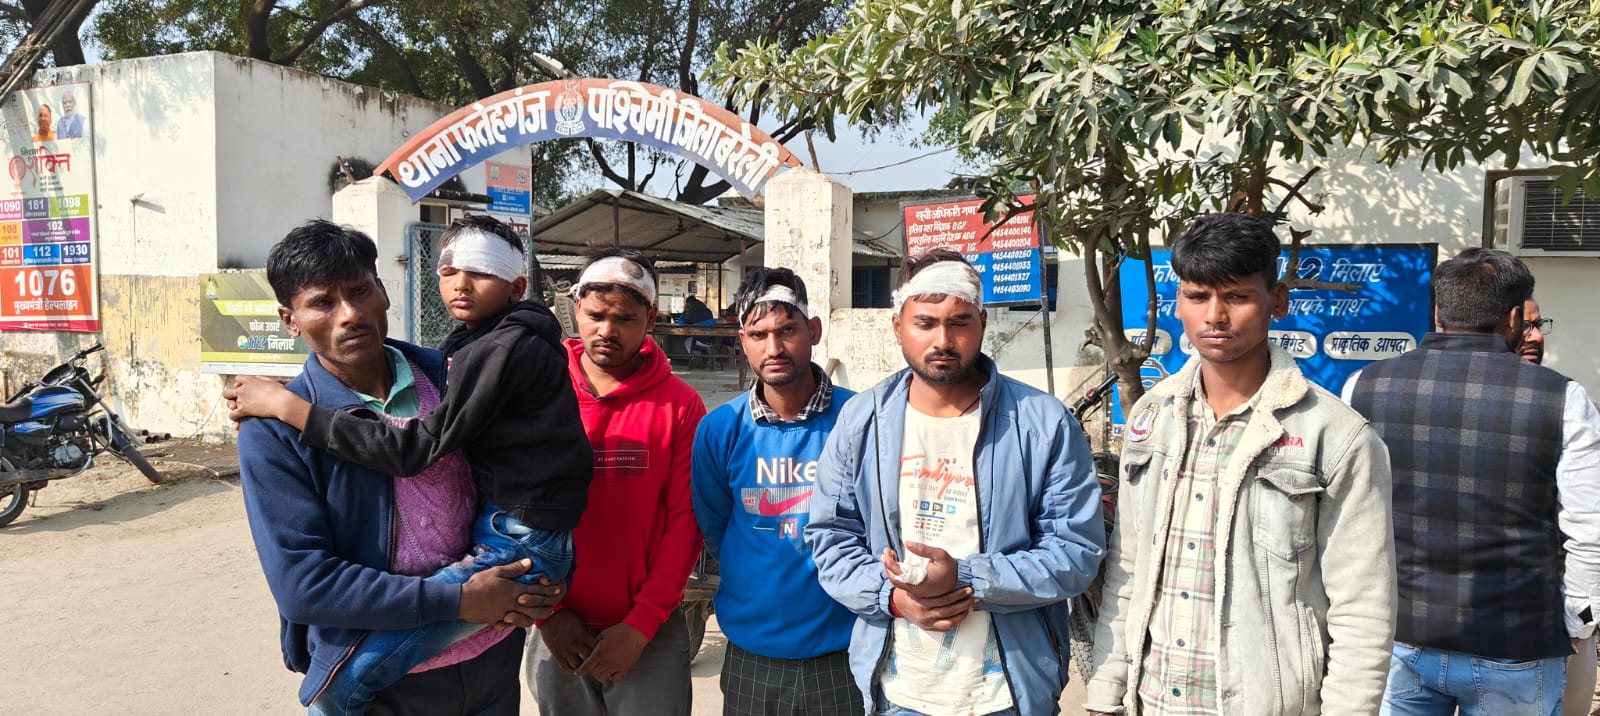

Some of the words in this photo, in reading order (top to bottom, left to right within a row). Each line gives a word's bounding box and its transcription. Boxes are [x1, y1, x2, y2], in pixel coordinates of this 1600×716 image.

[398, 127, 463, 188] थाना
[714, 123, 780, 192] बरेली
[28, 199, 44, 210] 181
[58, 197, 80, 208] 1098
[47, 221, 63, 231] 102
[2, 247, 19, 259] 101
[33, 246, 51, 257] 112
[63, 244, 88, 256] 1930
[14, 269, 76, 297] 1076
[756, 457, 818, 484] Nike
